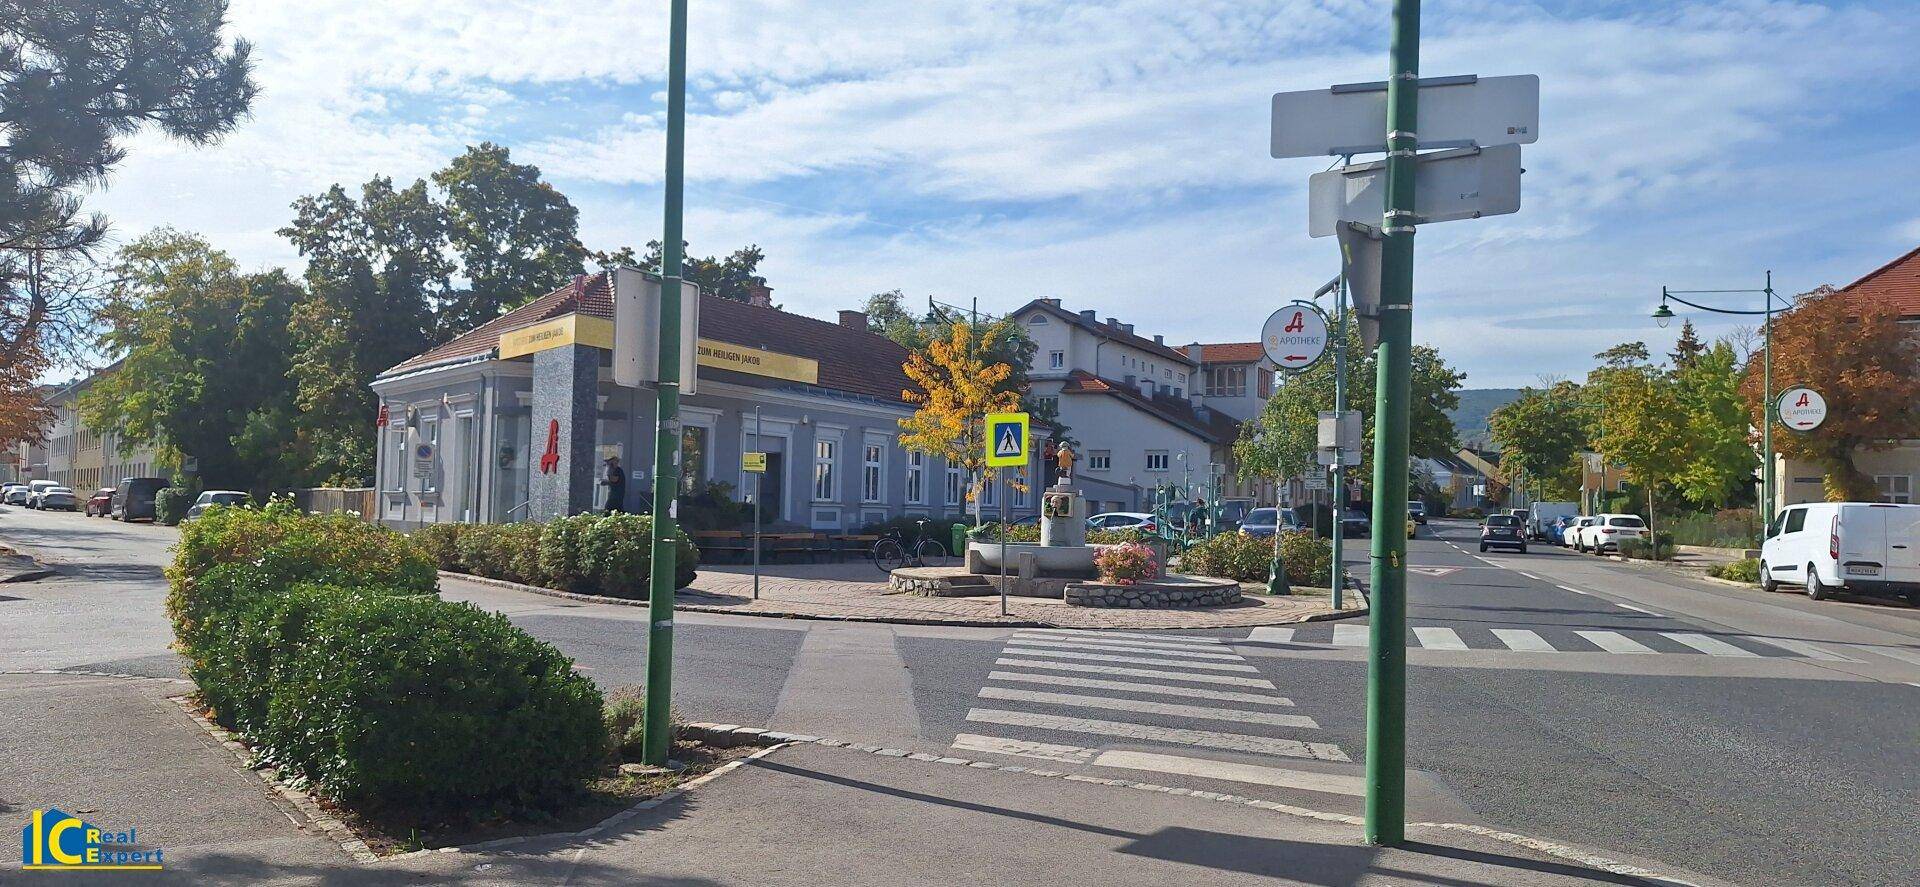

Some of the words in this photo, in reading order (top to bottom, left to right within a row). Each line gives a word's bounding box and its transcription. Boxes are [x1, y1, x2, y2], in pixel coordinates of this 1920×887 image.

[1284, 311, 1304, 333] A
[1279, 336, 1321, 346] APOTHEKE
[697, 345, 712, 357] ZUM
[712, 349, 740, 361] HEILIGEN
[741, 354, 761, 366] JAKOB
[1795, 392, 1810, 407] A
